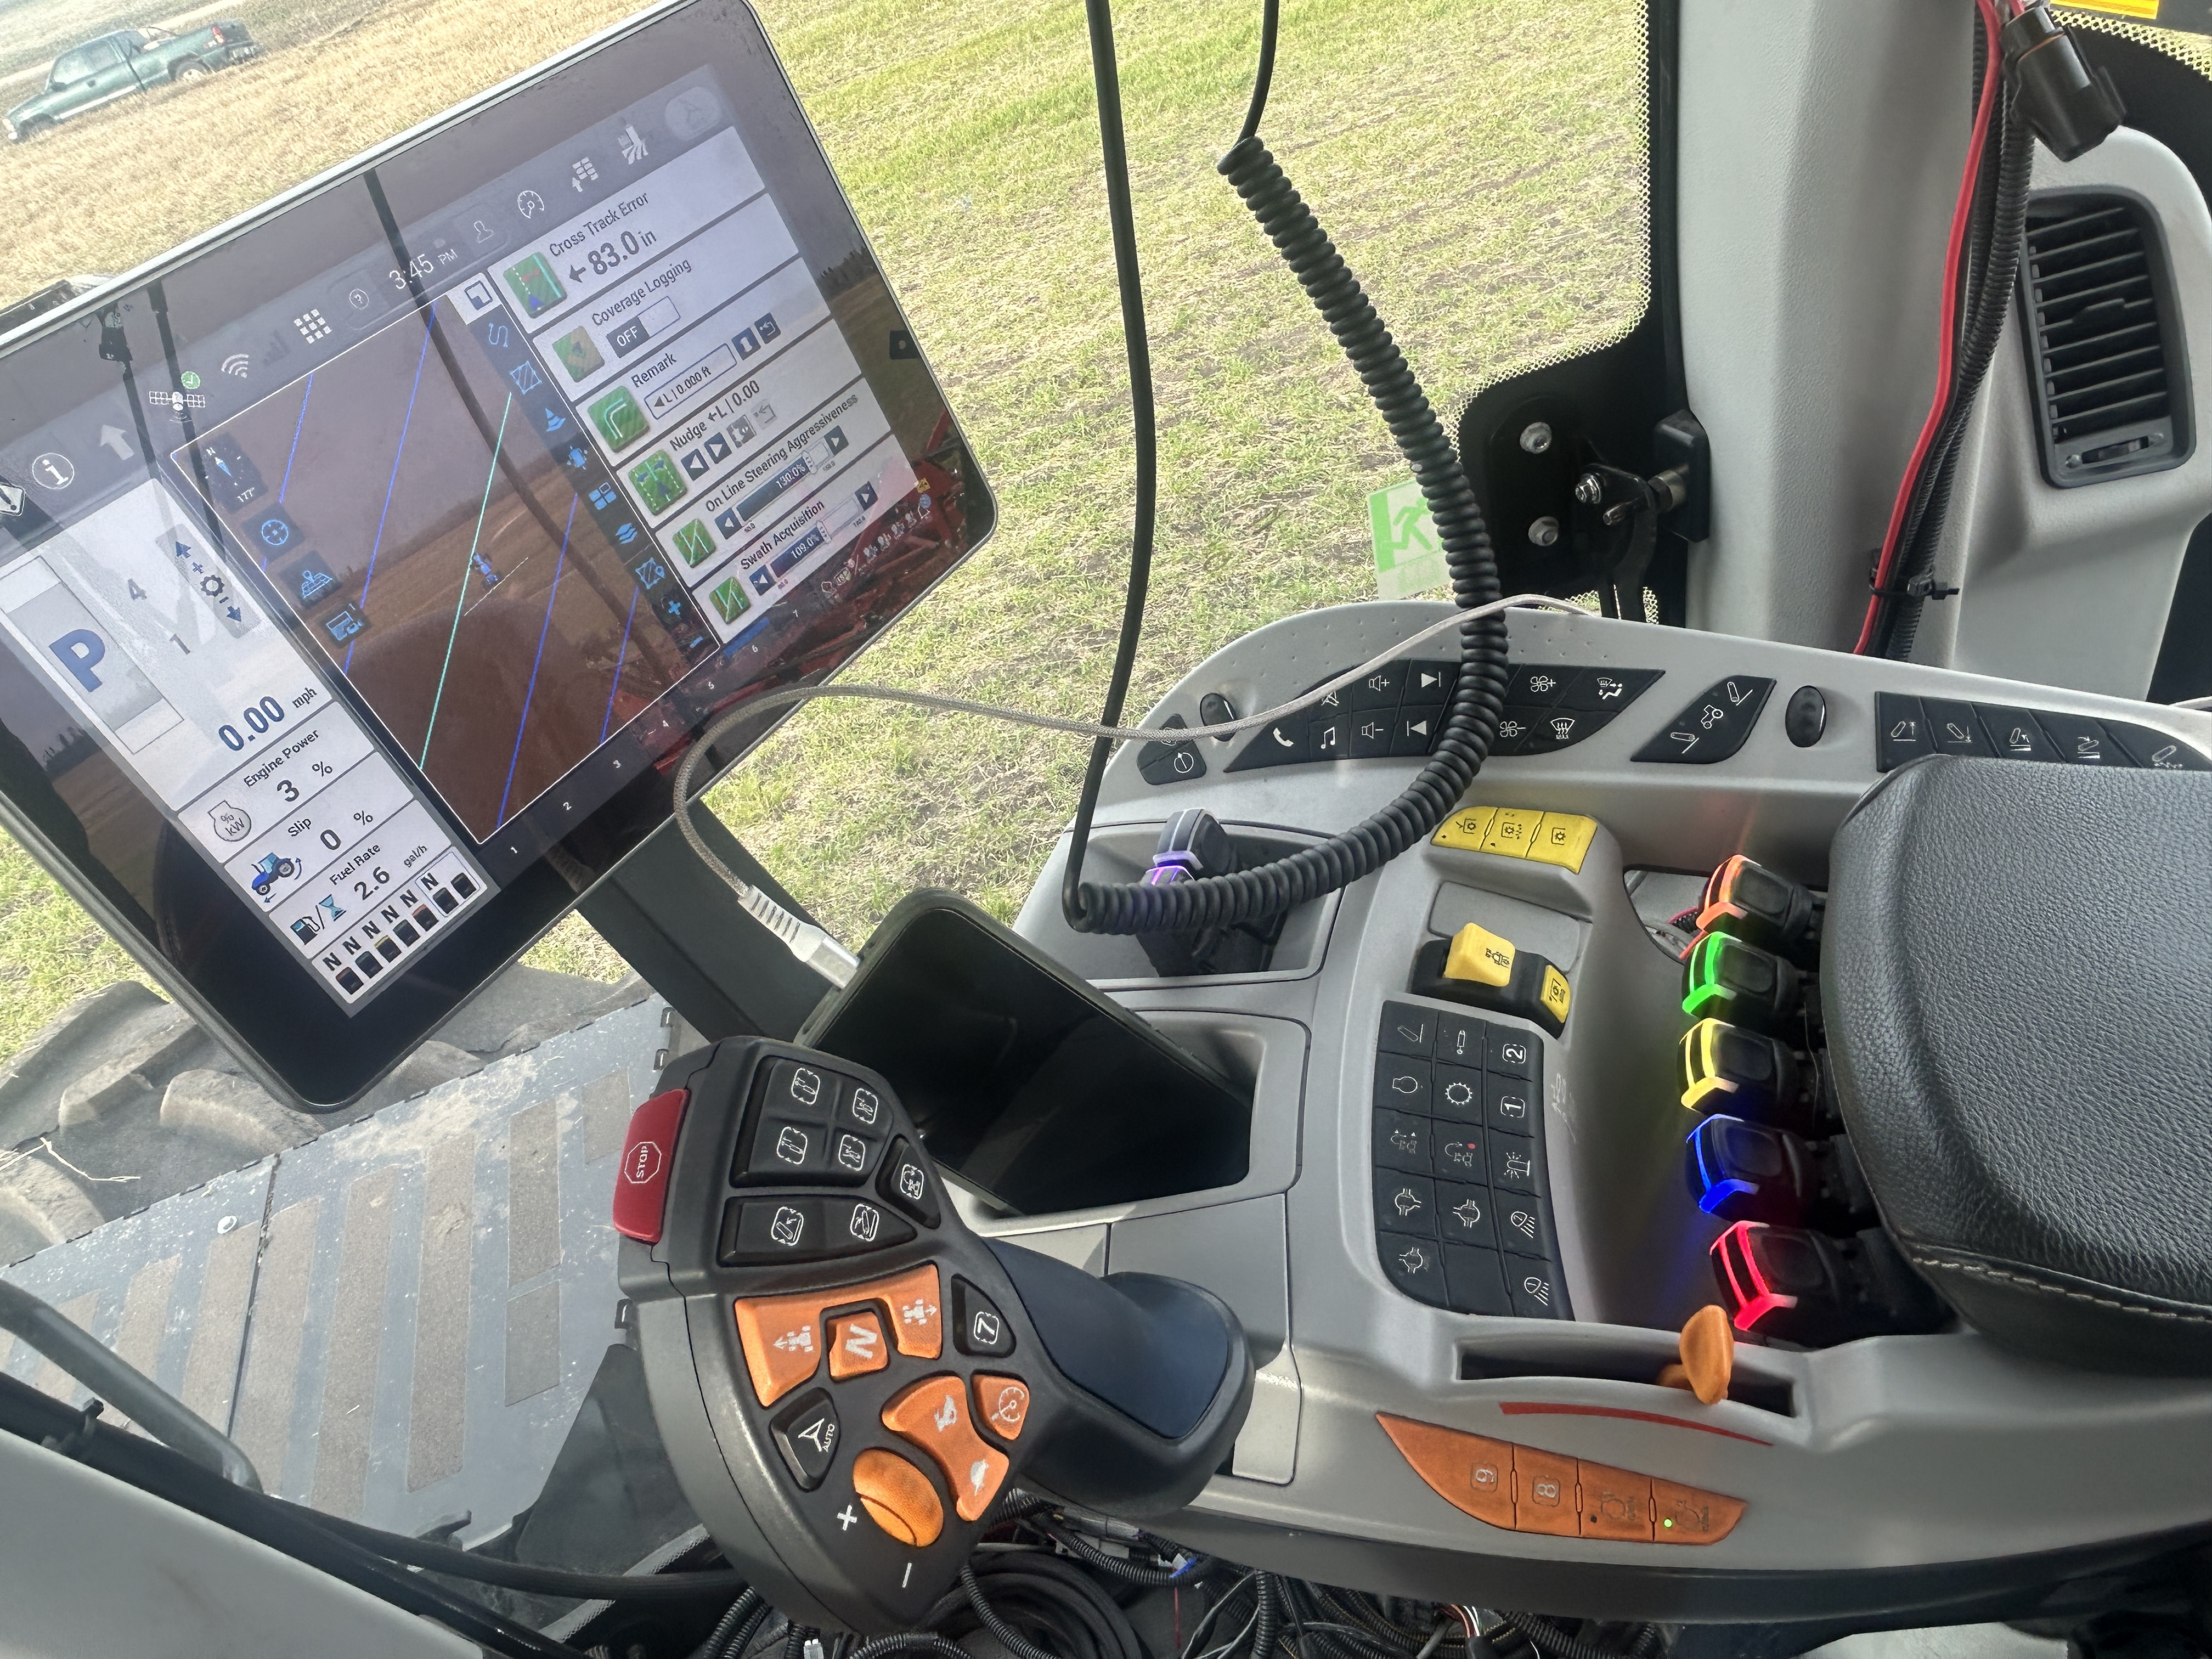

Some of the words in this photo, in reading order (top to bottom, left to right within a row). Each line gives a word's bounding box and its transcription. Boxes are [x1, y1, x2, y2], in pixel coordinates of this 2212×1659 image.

[550, 232, 585, 257] Cross
[583, 210, 620, 236] Track
[618, 193, 649, 217] Error
[389, 253, 434, 290] 3:45
[438, 249, 458, 265] PM
[588, 231, 640, 275] 83.0
[638, 230, 657, 246] in
[592, 287, 646, 326] Coverage
[644, 259, 692, 292] Logging
[617, 326, 638, 347] OFF
[631, 353, 677, 388] Remark
[678, 373, 702, 394] 0.000
[701, 366, 712, 377] ft
[670, 422, 708, 450] Nudge
[732, 380, 760, 406] 0.00
[706, 495, 724, 512] On
[721, 479, 746, 500] Line
[744, 448, 788, 483] Steering
[787, 394, 858, 452] Aggressiveness
[741, 541, 773, 570] Swath
[772, 500, 825, 546] Acquisition
[127, 578, 147, 600] 4
[48, 629, 105, 692] P
[170, 633, 191, 655] 1
[218, 696, 285, 751] 0.00
[292, 687, 318, 708] mph
[244, 757, 284, 788] Engine
[281, 730, 319, 759] Power
[276, 780, 300, 802] 3
[312, 761, 333, 777] %
[563, 802, 572, 811] 2
[612, 760, 622, 769] 3
[225, 817, 245, 836] kW
[287, 818, 312, 837] Slip
[320, 829, 341, 850] 0
[353, 810, 374, 825] %
[329, 862, 356, 885] Fuel
[353, 845, 381, 866] Rate
[354, 866, 390, 900] 2.6
[403, 845, 428, 868] gal/h
[323, 952, 342, 971] N
[342, 936, 362, 955] N
[362, 920, 381, 939] N
[381, 905, 400, 923] N
[399, 889, 418, 908] N
[420, 872, 439, 890] N
[1506, 1048, 1523, 1059] 2
[636, 1146, 648, 1179] STOP
[845, 1323, 877, 1359] N
[977, 1317, 995, 1335] 7
[822, 1423, 835, 1453] AUTO
[1476, 1469, 1494, 1482] 9
[1537, 1483, 1556, 1498] 8
